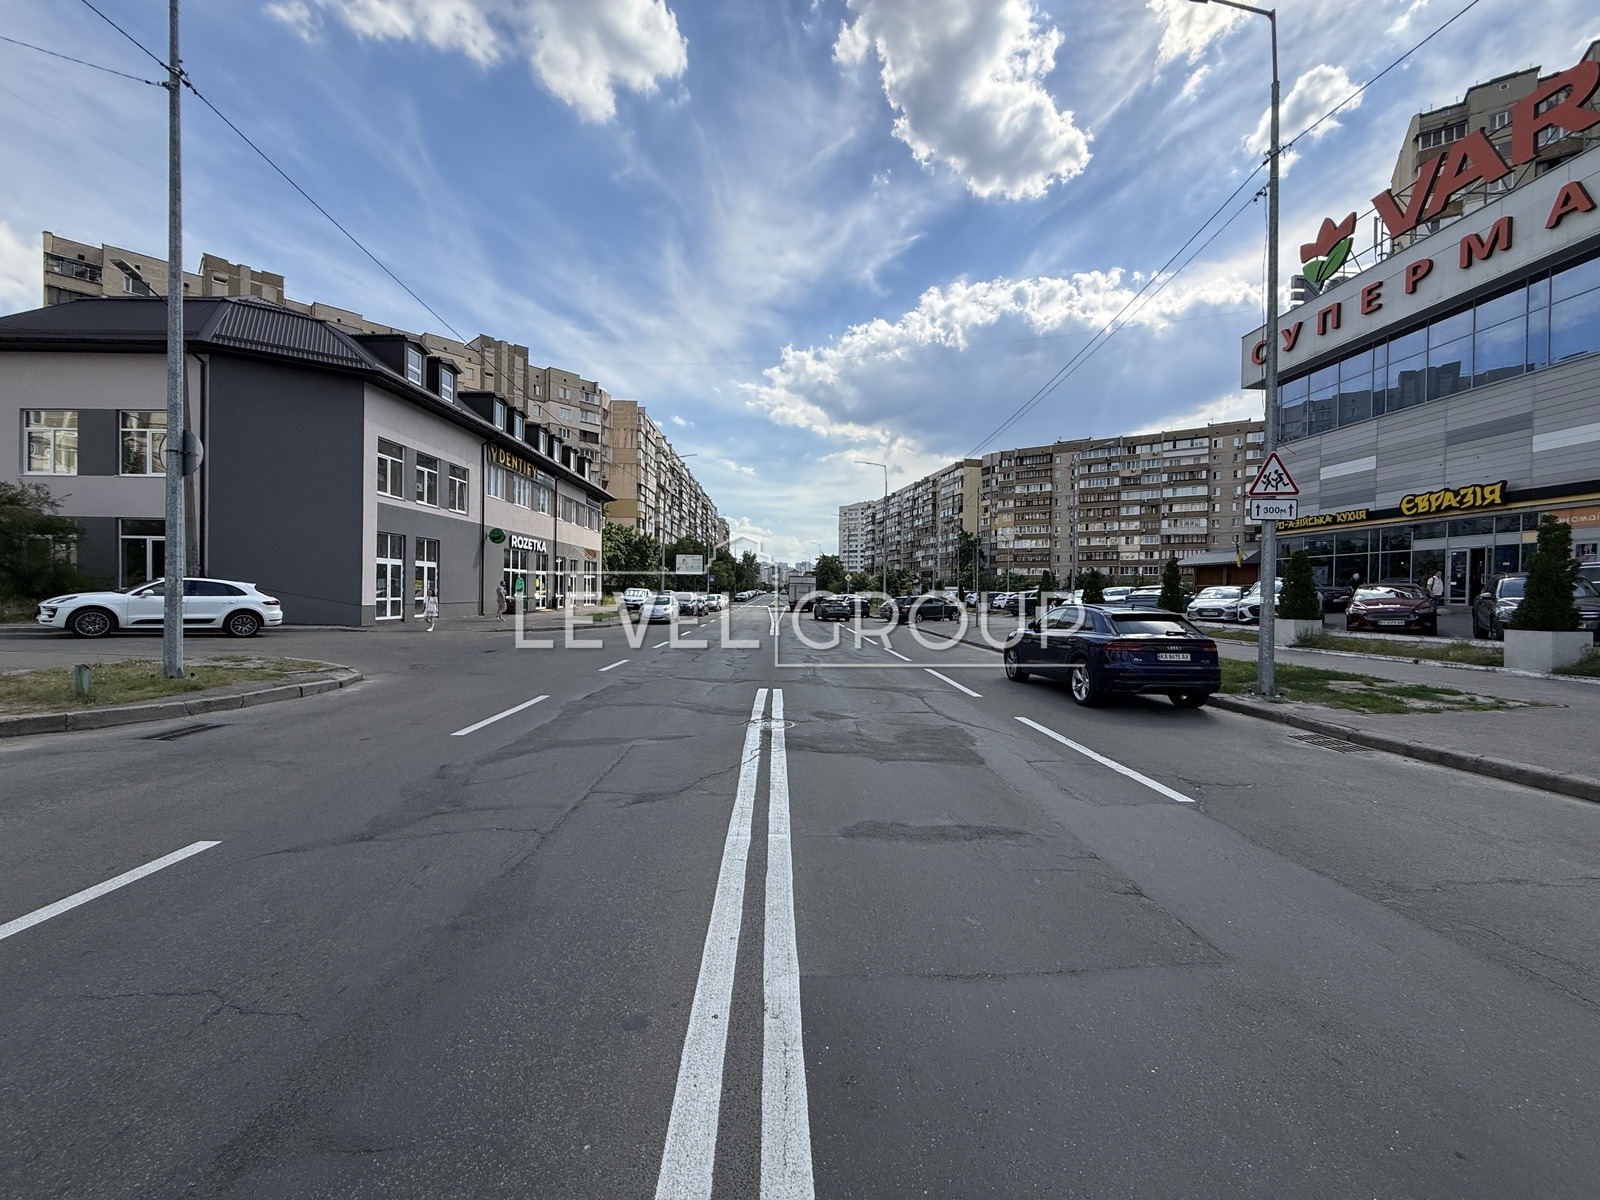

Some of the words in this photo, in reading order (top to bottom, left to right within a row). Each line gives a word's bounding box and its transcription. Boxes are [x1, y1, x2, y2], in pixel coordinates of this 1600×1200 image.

[1371, 60, 1600, 241] VAR
[499, 448, 538, 479] DENTIFY
[1400, 482, 1503, 516] ЄВРАЗІЯ
[1336, 509, 1367, 523] КУХНЯ
[511, 534, 547, 552] ROZETKA
